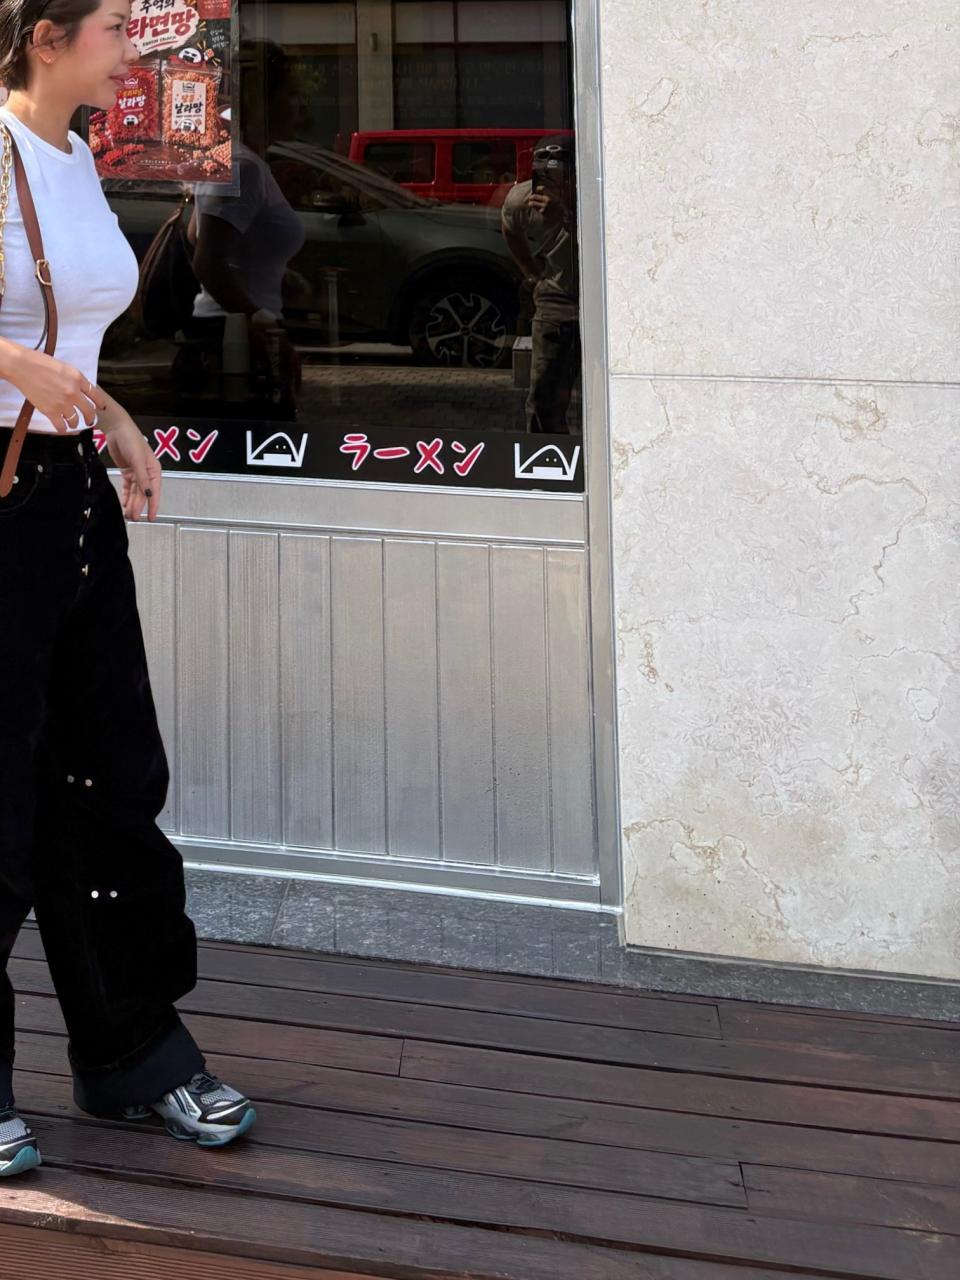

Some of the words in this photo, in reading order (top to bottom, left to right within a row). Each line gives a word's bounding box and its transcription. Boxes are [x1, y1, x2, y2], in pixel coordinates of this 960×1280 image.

[127, 8, 196, 40] 라면땅
[339, 432, 485, 476] ラーメン
